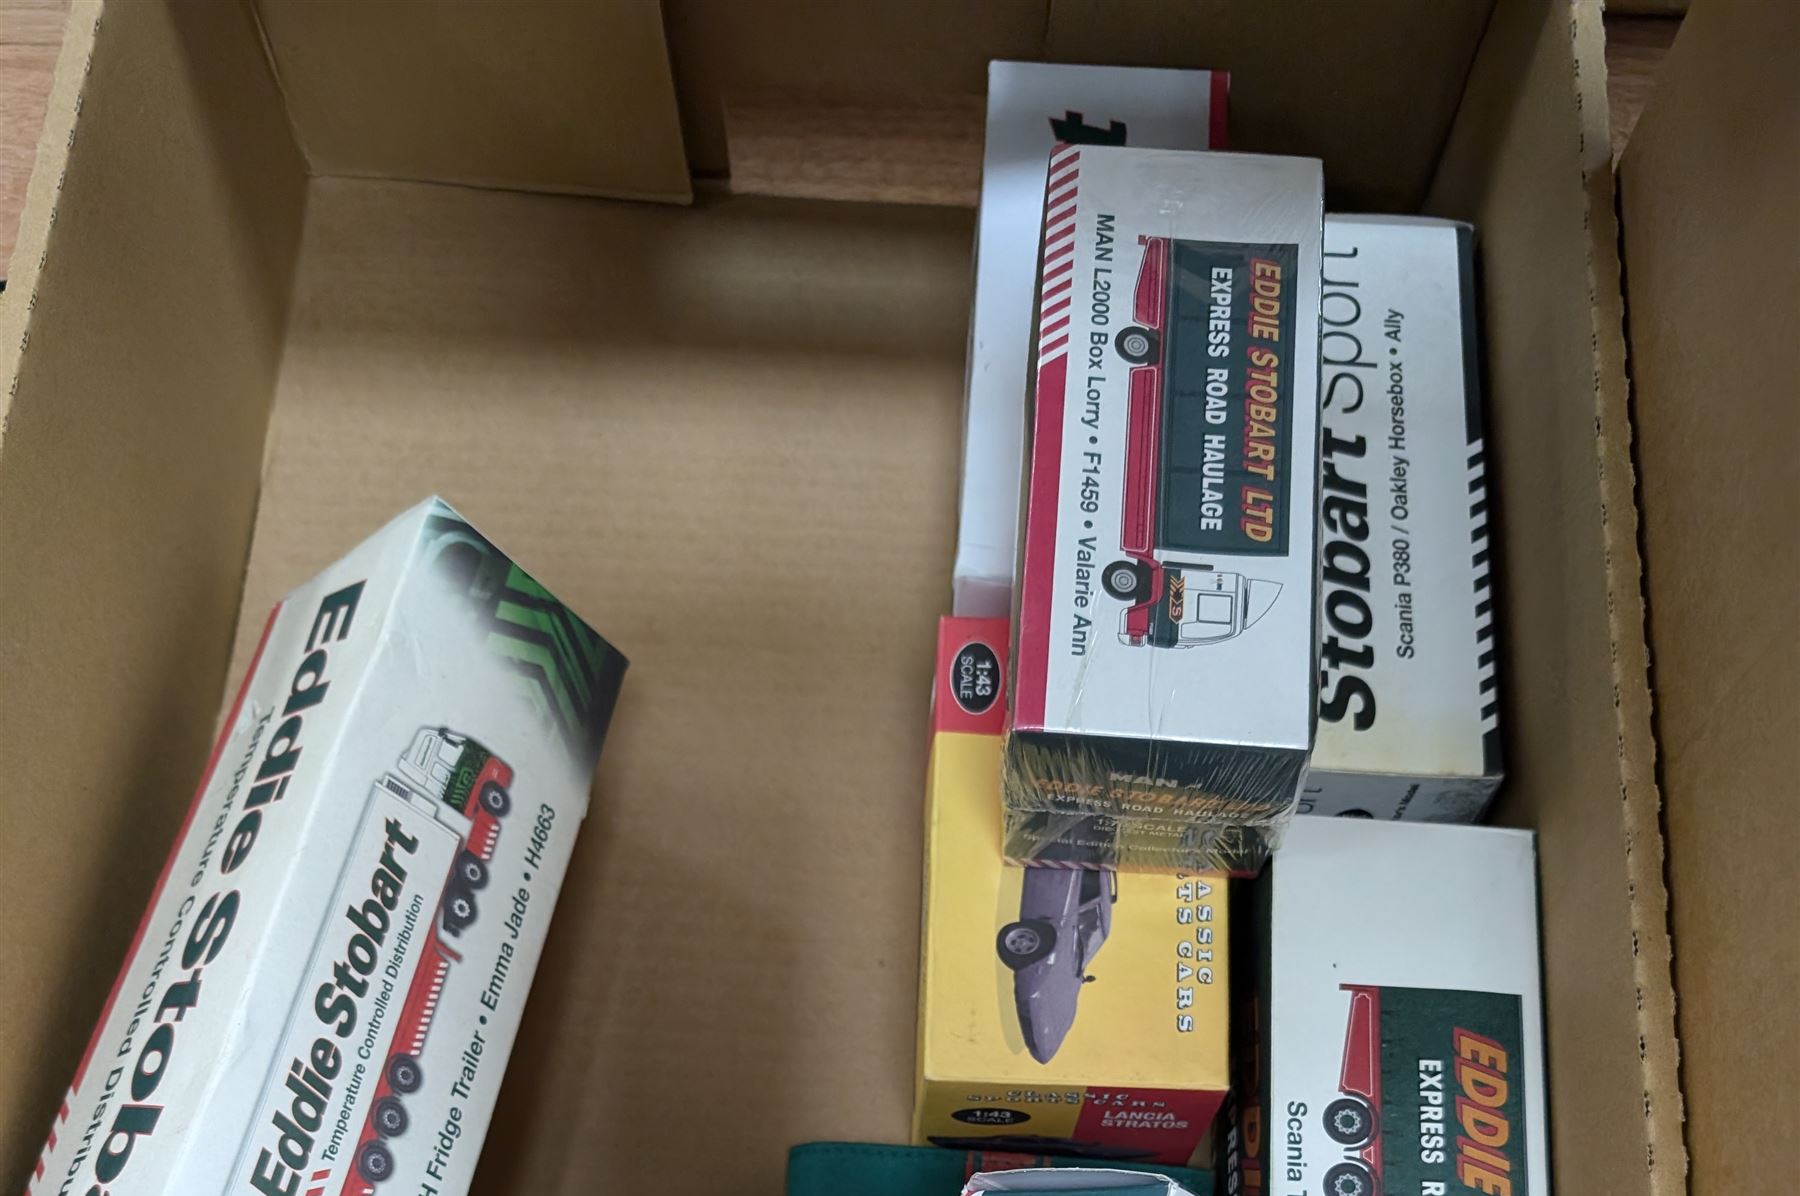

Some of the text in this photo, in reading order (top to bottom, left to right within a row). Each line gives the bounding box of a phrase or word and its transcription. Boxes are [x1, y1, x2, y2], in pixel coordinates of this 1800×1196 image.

[1384, 308, 1405, 343] Ally
[1071, 213, 1116, 656] MAN L2000 Box Lorry F1459 Valarie Ann
[1200, 266, 1233, 531] EXPRESS ROAD HAULAGE
[1240, 257, 1282, 543] EDDIE STOBART LTD
[1387, 362, 1406, 450] Horsebox
[1390, 455, 1411, 522] Oakley
[1319, 426, 1377, 732] Stobart
[1392, 539, 1411, 586] P380
[1395, 592, 1415, 660] Scania
[960, 655, 975, 699] SCALE
[975, 660, 993, 697] 1:43
[220, 579, 368, 875] Eddie
[190, 703, 276, 890] Temperature
[1047, 793, 1249, 819] EXPRESS ROAD HAULAGE
[1109, 772, 1178, 789] MAN
[313, 816, 420, 1040] Stobart
[1196, 880, 1213, 985] ASSIC
[115, 895, 197, 1062] Controlled
[425, 1106, 463, 1183] Fridge
[450, 1030, 487, 1100] Trailer
[480, 941, 515, 1013] Emma
[504, 888, 532, 940] Jade
[523, 803, 557, 871] H4663
[1177, 941, 1194, 1033] CARS
[321, 893, 425, 1163] Temperature Controlled Distribution
[972, 1109, 1012, 1119] 1:43
[1099, 1118, 1189, 1129] STRATOS
[1102, 1109, 1175, 1121] LANCIA
[1286, 1100, 1309, 1182] Scania
[1417, 1058, 1447, 1166] EXPRESS
